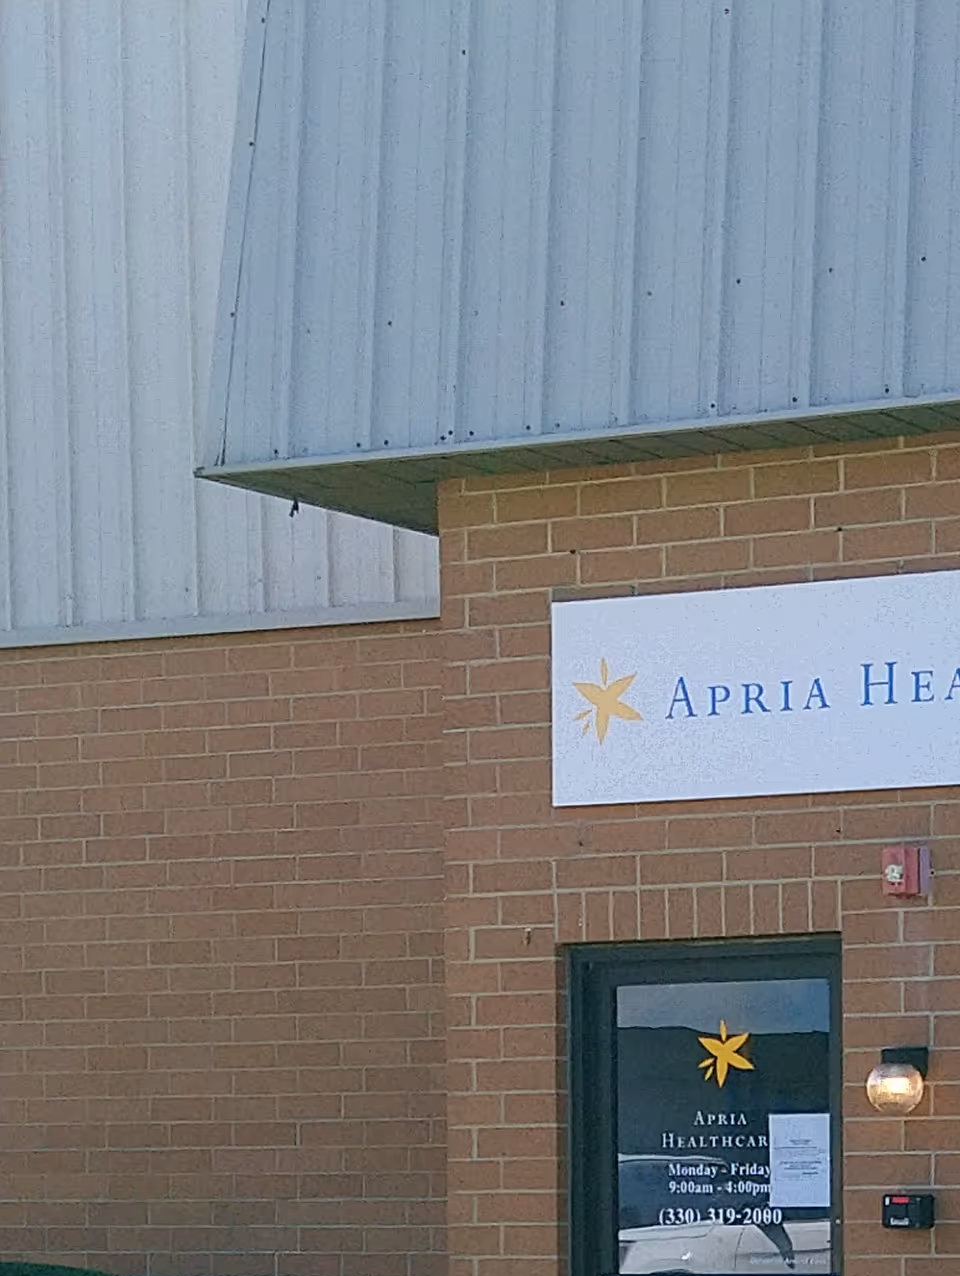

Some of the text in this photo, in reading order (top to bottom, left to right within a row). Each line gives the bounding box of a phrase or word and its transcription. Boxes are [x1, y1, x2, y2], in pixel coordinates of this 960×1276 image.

[665, 676, 831, 719] APRIA
[694, 1110, 747, 1125] APRIA
[662, 1132, 768, 1148] HEALTHCAR
[668, 1163, 718, 1178] Monday
[731, 1163, 771, 1178] Friday
[668, 1181, 713, 1194] 9:00am
[659, 1207, 701, 1225] (330)
